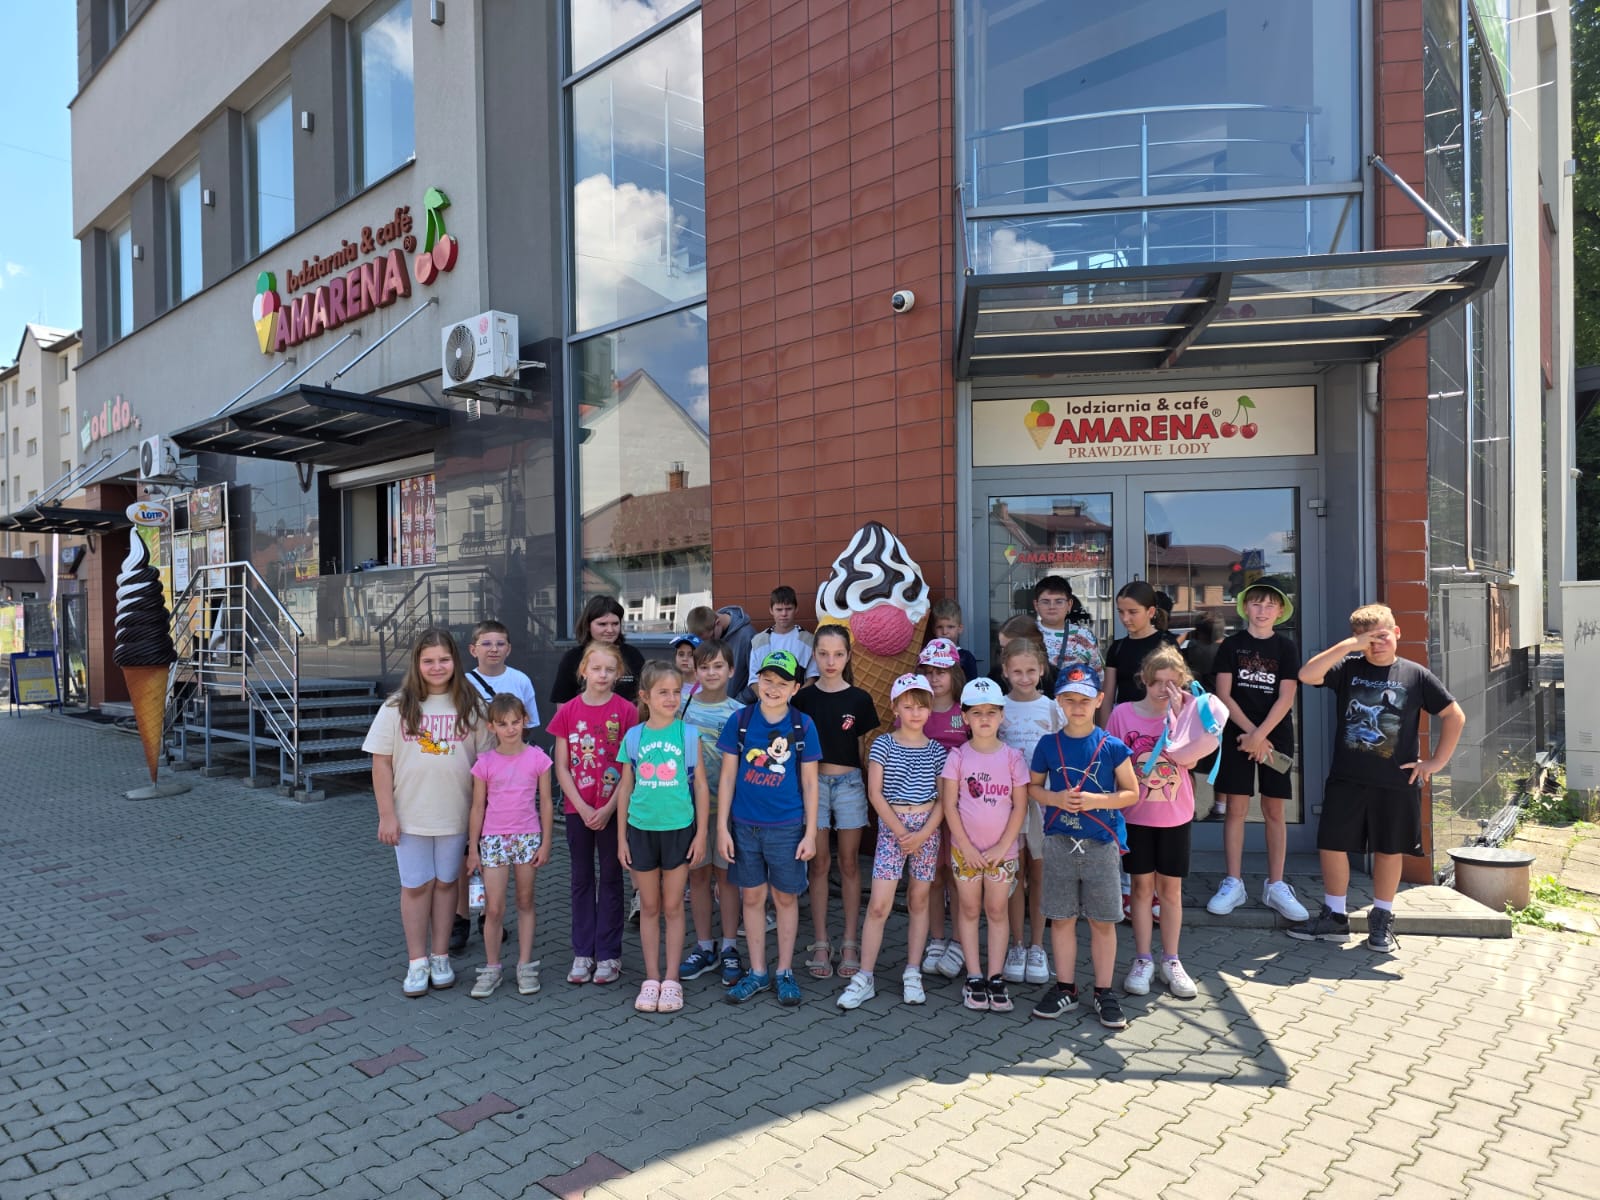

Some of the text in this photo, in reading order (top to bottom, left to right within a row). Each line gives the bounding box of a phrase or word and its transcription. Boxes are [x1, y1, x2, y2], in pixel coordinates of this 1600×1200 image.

[285, 206, 413, 294] lodziarnia & café
[480, 335, 488, 346] LG
[1066, 396, 1209, 415] lodziarnia & café
[91, 395, 131, 441] odido
[1068, 442, 1212, 459] PRAWDZIWE LODY
[141, 511, 163, 520] LOTTO
[641, 741, 662, 754] love
[663, 741, 682, 756] you
[658, 778, 679, 787] much
[743, 768, 786, 787] MICKEY
